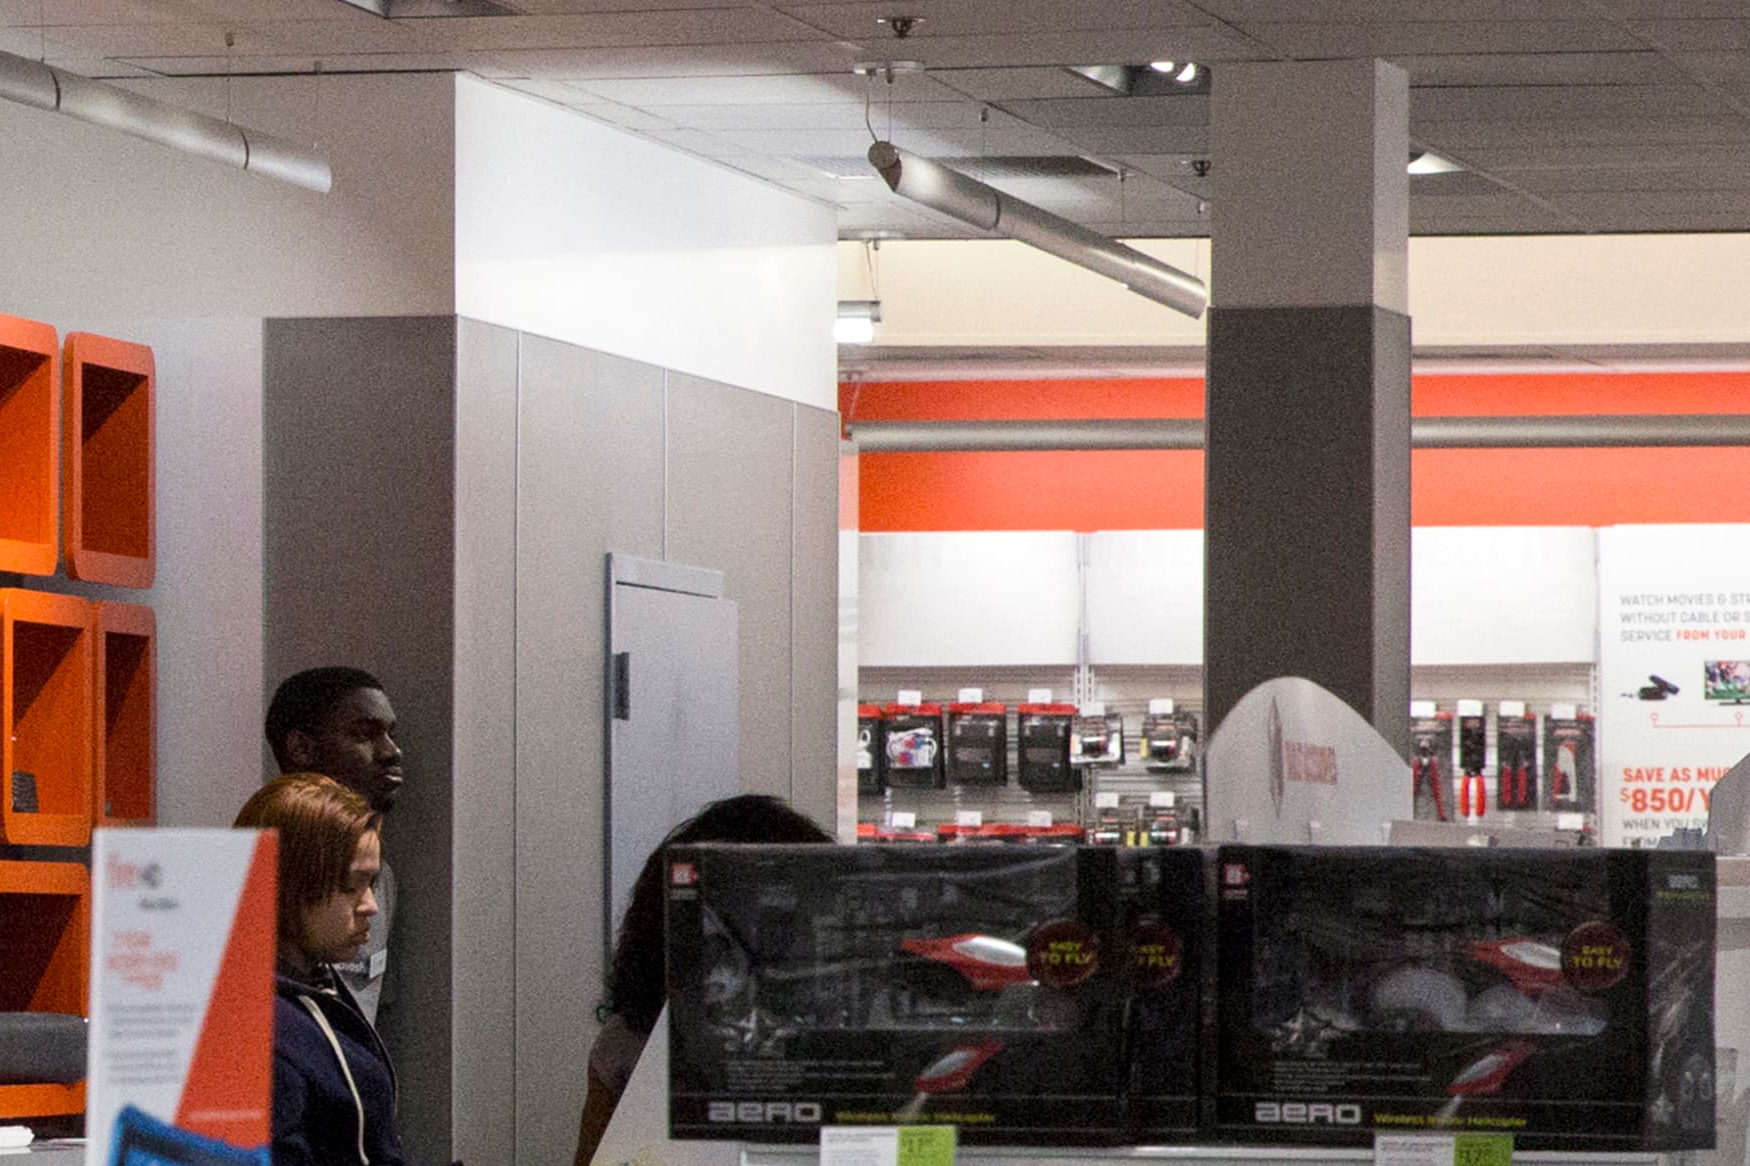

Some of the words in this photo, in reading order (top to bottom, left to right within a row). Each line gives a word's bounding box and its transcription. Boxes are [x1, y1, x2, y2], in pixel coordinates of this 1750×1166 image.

[1619, 593, 1664, 606] WATCH
[1667, 592, 1714, 606] MOVIES
[1619, 611, 1677, 624] WITHOUT
[1680, 611, 1720, 624] CABLE
[1723, 611, 1740, 623] OR
[1619, 629, 1672, 642] SERVICE
[1676, 629, 1710, 641] FROM
[1713, 629, 1747, 641] YOUR
[1622, 767, 1665, 783] SAVE
[1669, 767, 1691, 783] AS
[1064, 951, 1094, 965] FLY
[1572, 956, 1593, 968] TO
